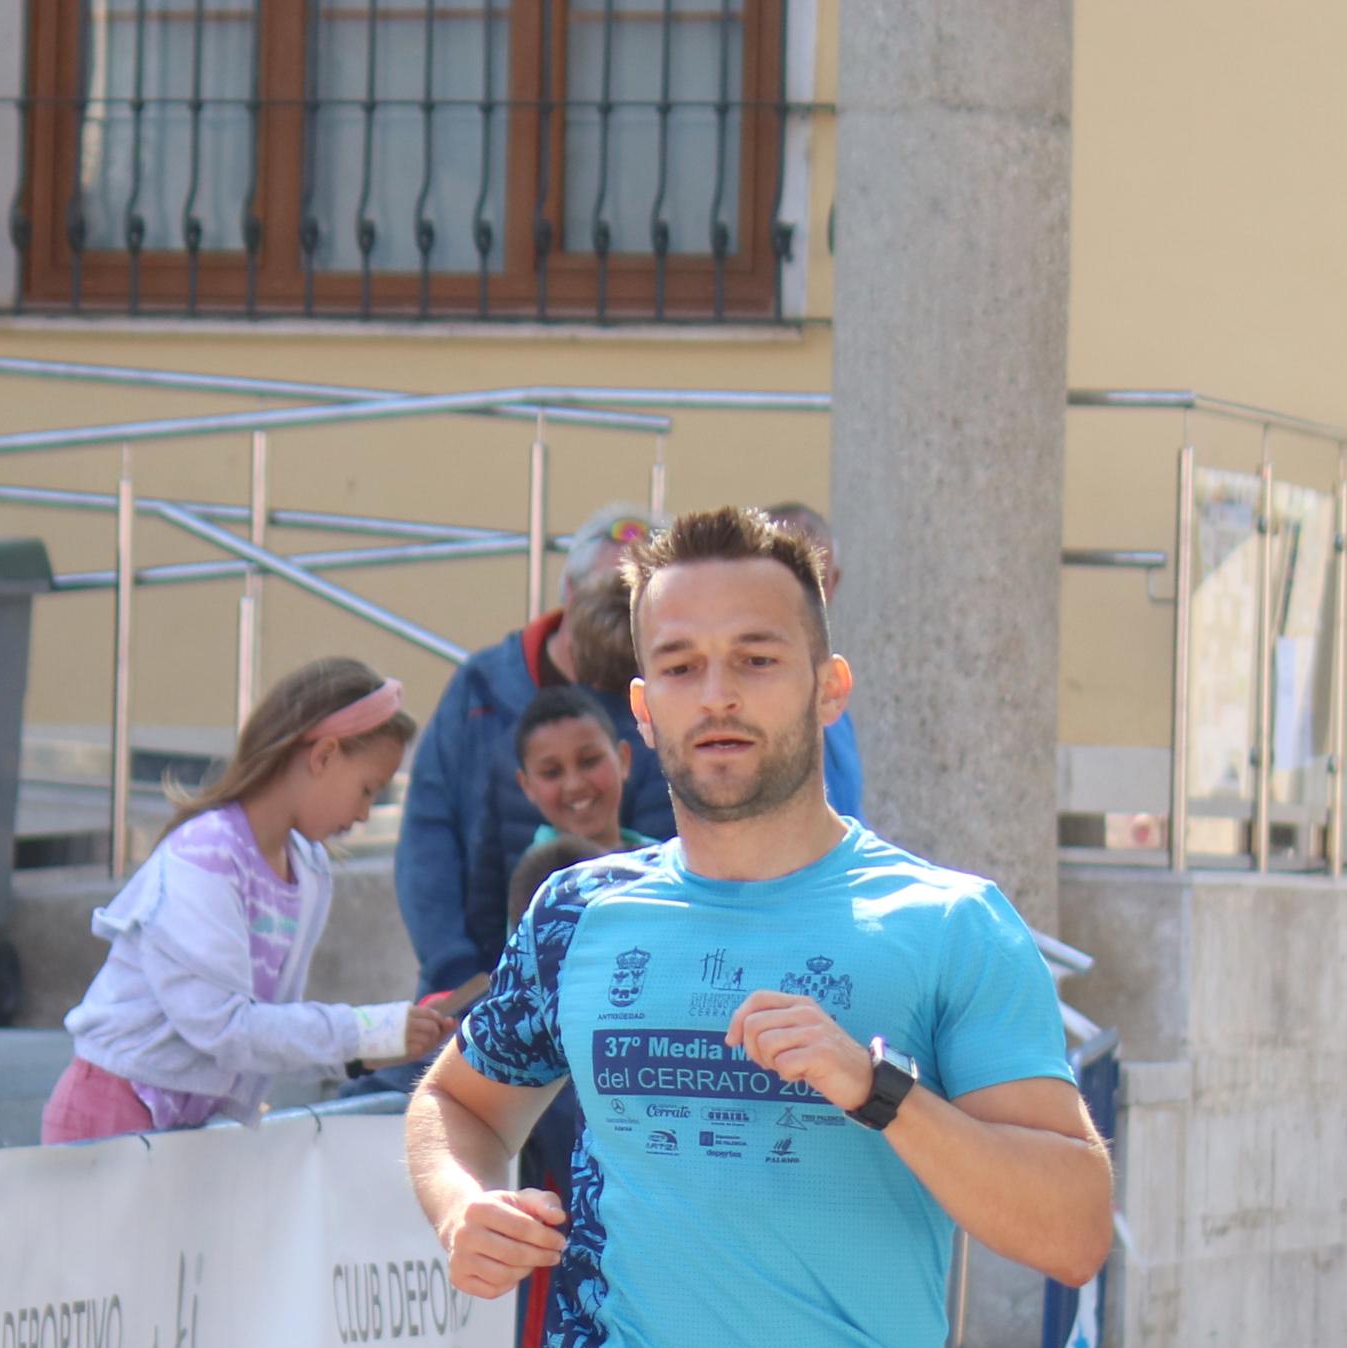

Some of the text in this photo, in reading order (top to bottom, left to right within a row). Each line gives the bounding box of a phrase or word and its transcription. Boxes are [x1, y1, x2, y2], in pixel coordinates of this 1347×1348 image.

[648, 1037, 723, 1060] Media
[597, 1068, 630, 1089] del
[637, 1067, 770, 1094] CERRATO
[332, 1262, 383, 1344] CLUB
